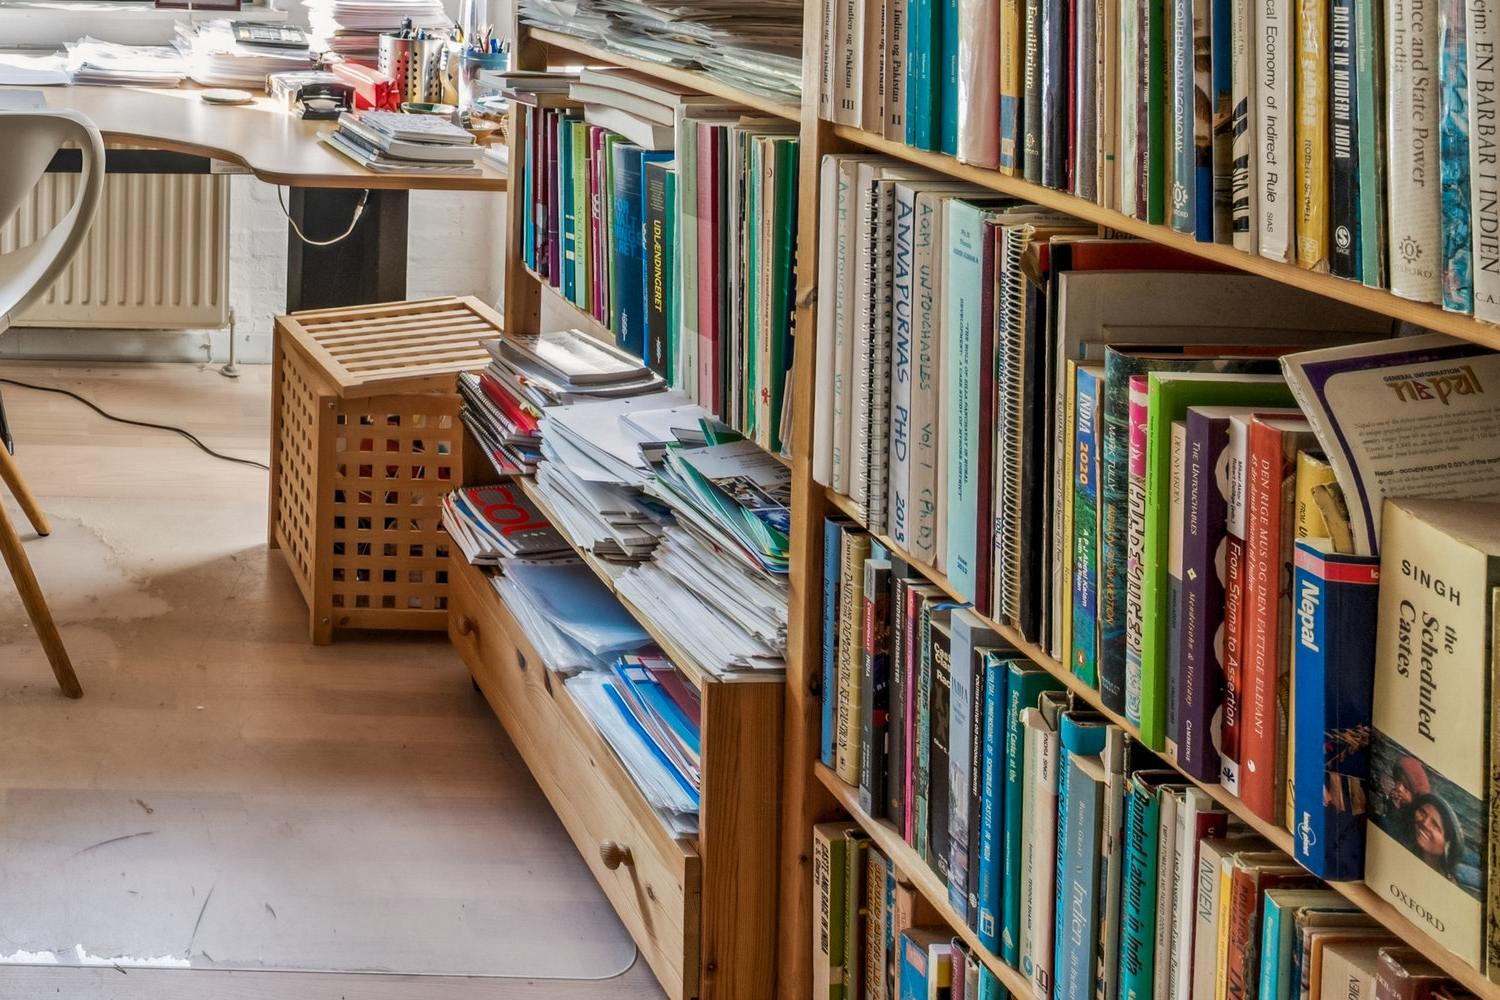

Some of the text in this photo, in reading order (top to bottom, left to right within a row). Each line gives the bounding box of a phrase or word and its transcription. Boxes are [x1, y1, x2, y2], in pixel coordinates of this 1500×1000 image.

[1025, 6, 1038, 89] Equilibrium
[1333, 6, 1349, 47] DALITS
[1394, 27, 1407, 72] India
[1412, 36, 1428, 72] and
[1475, 41, 1494, 72] EN
[1263, 25, 1278, 90] Economy
[1333, 53, 1349, 65] IN
[1267, 96, 1278, 110] of
[1333, 70, 1350, 120] MODERN
[1412, 76, 1431, 120] State
[1477, 80, 1497, 164] BARBAR
[1267, 115, 1278, 165] Indirect
[1334, 124, 1350, 158] INDIA
[1413, 127, 1429, 187] Power
[1267, 172, 1278, 202] Rule
[1480, 190, 1499, 275] INDIEN
[653, 220, 662, 312] UDLÆNDINGERET
[895, 198, 913, 383] ANNAPURNAS
[1383, 368, 1461, 382] GENERAL INFORMATION
[894, 405, 908, 462] PHD
[1078, 392, 1092, 485] INDIA 2020
[844, 573, 854, 606] DALITS
[1253, 459, 1270, 739] DEN RIGE MUS OG DEN FATTIGE ELEFANT
[1401, 559, 1460, 606] SINGH
[1225, 542, 1241, 727] From Stigma to Assertion
[1298, 579, 1319, 653] Nepal
[1396, 599, 1417, 678] Castes
[1444, 625, 1458, 654] the
[840, 619, 852, 685] DEMOCRATIC
[1417, 611, 1439, 743] Scheduled
[838, 686, 851, 750] REVOLUTION
[1126, 789, 1151, 977] Bonded Labour in India
[1199, 856, 1214, 923] INDIEN
[1388, 882, 1447, 934] OXFORD
[1071, 881, 1085, 946] Indien
